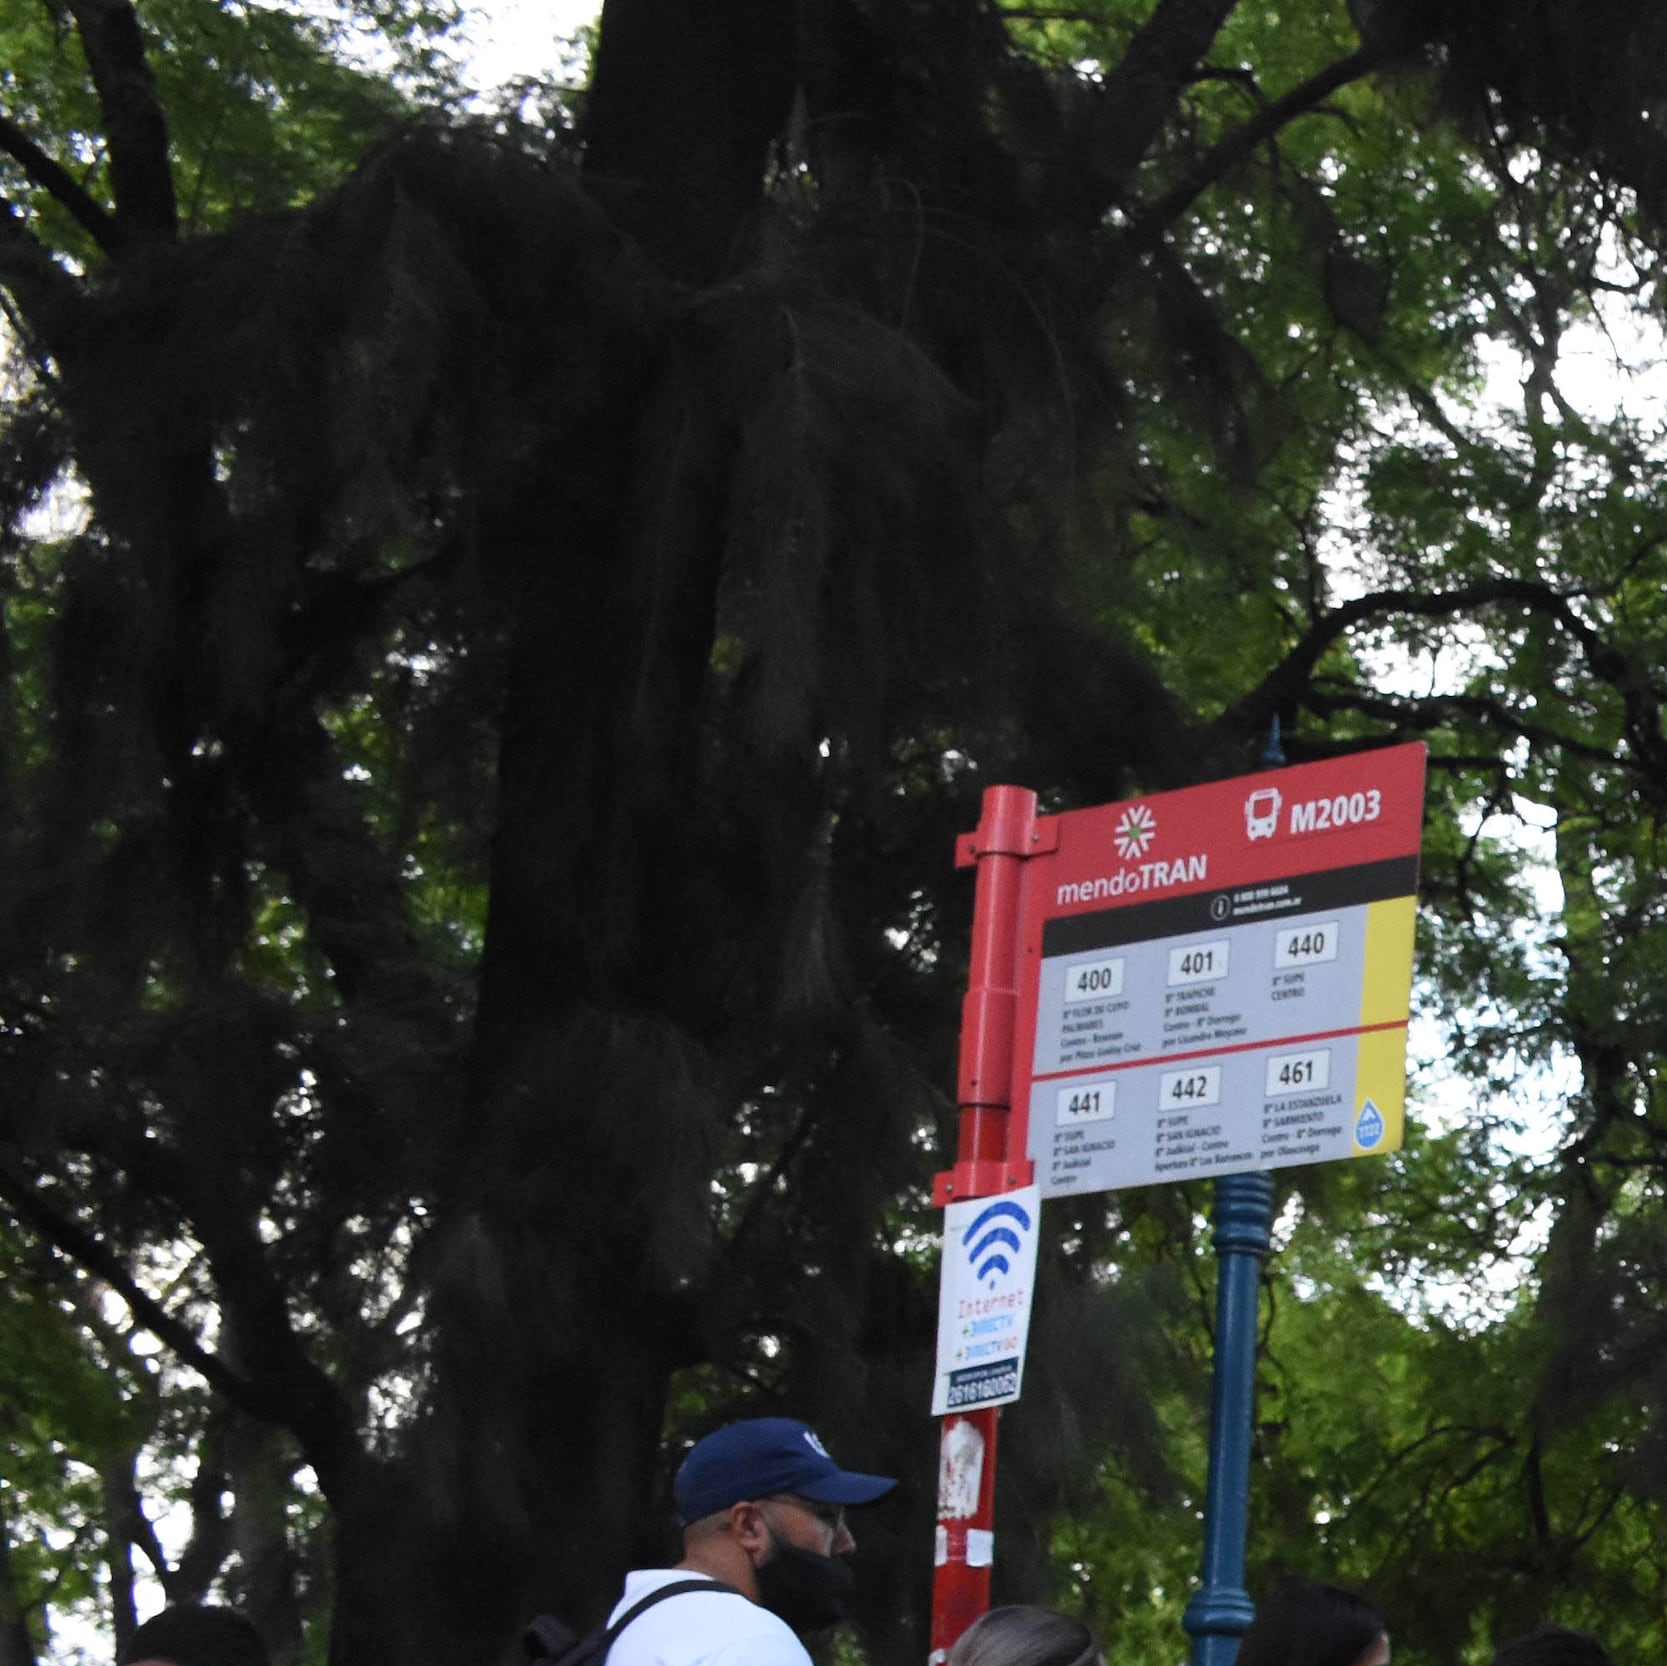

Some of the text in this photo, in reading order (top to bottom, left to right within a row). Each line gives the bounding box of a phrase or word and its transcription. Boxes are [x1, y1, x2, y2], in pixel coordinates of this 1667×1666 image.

[1291, 789, 1381, 834] M2003
[1056, 853, 1209, 905] mendoTRAN
[1288, 932, 1325, 957] 440
[1180, 951, 1213, 975] 401
[1077, 967, 1112, 993] 400
[1271, 987, 1305, 1002] CENTRO
[1279, 1060, 1313, 1085] 461
[1171, 1075, 1208, 1100] 442
[1068, 1090, 1101, 1115] 441
[1167, 1130, 1183, 1141] SAN
[958, 1290, 1023, 1319] Internet
